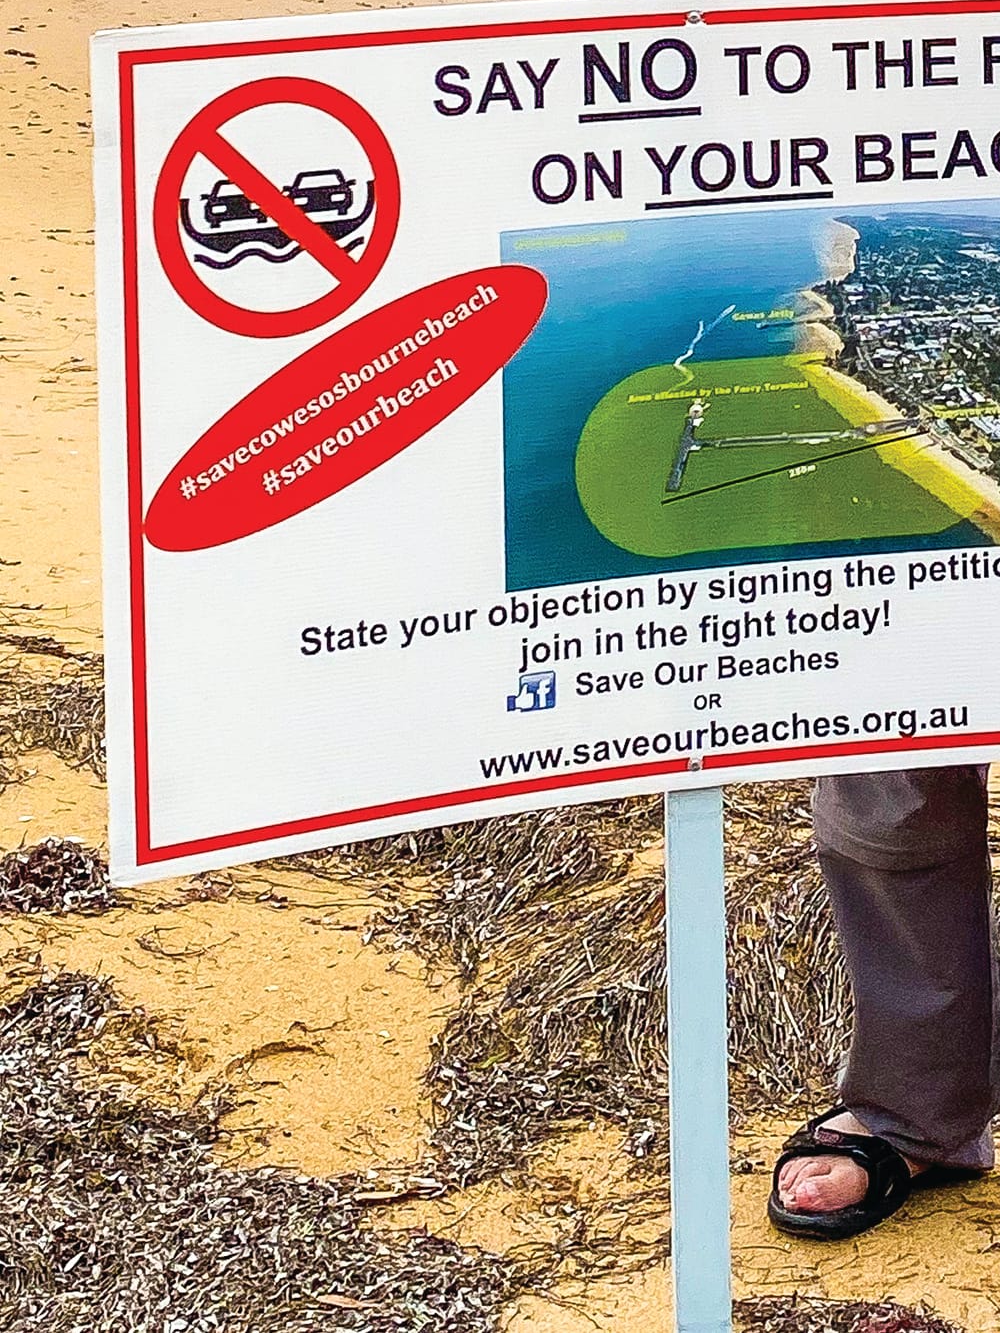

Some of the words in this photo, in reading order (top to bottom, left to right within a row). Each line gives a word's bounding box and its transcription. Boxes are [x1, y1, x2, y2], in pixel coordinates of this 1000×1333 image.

[433, 57, 561, 117] SAY
[582, 38, 699, 107] NO
[723, 44, 811, 97] TO
[831, 37, 959, 91] THE
[532, 149, 623, 205] ON
[644, 137, 833, 197] YOUR
[179, 283, 499, 500] #savecowesosbournebeach
[262, 356, 460, 496] #saveourbeach
[300, 620, 389, 656] State
[399, 608, 478, 649] your
[488, 584, 644, 629] objection
[658, 577, 698, 611] by
[708, 568, 832, 604] signing
[843, 558, 896, 588] the
[518, 633, 582, 674] join
[596, 627, 623, 656] in
[635, 621, 688, 651] the
[698, 612, 776, 647] fight
[785, 599, 892, 636] today!
[575, 671, 644, 697] Save
[654, 662, 708, 687] Our
[717, 648, 839, 680] Beaches
[693, 693, 722, 712] OR
[479, 705, 968, 780] www.saveourbeaches.org.au
